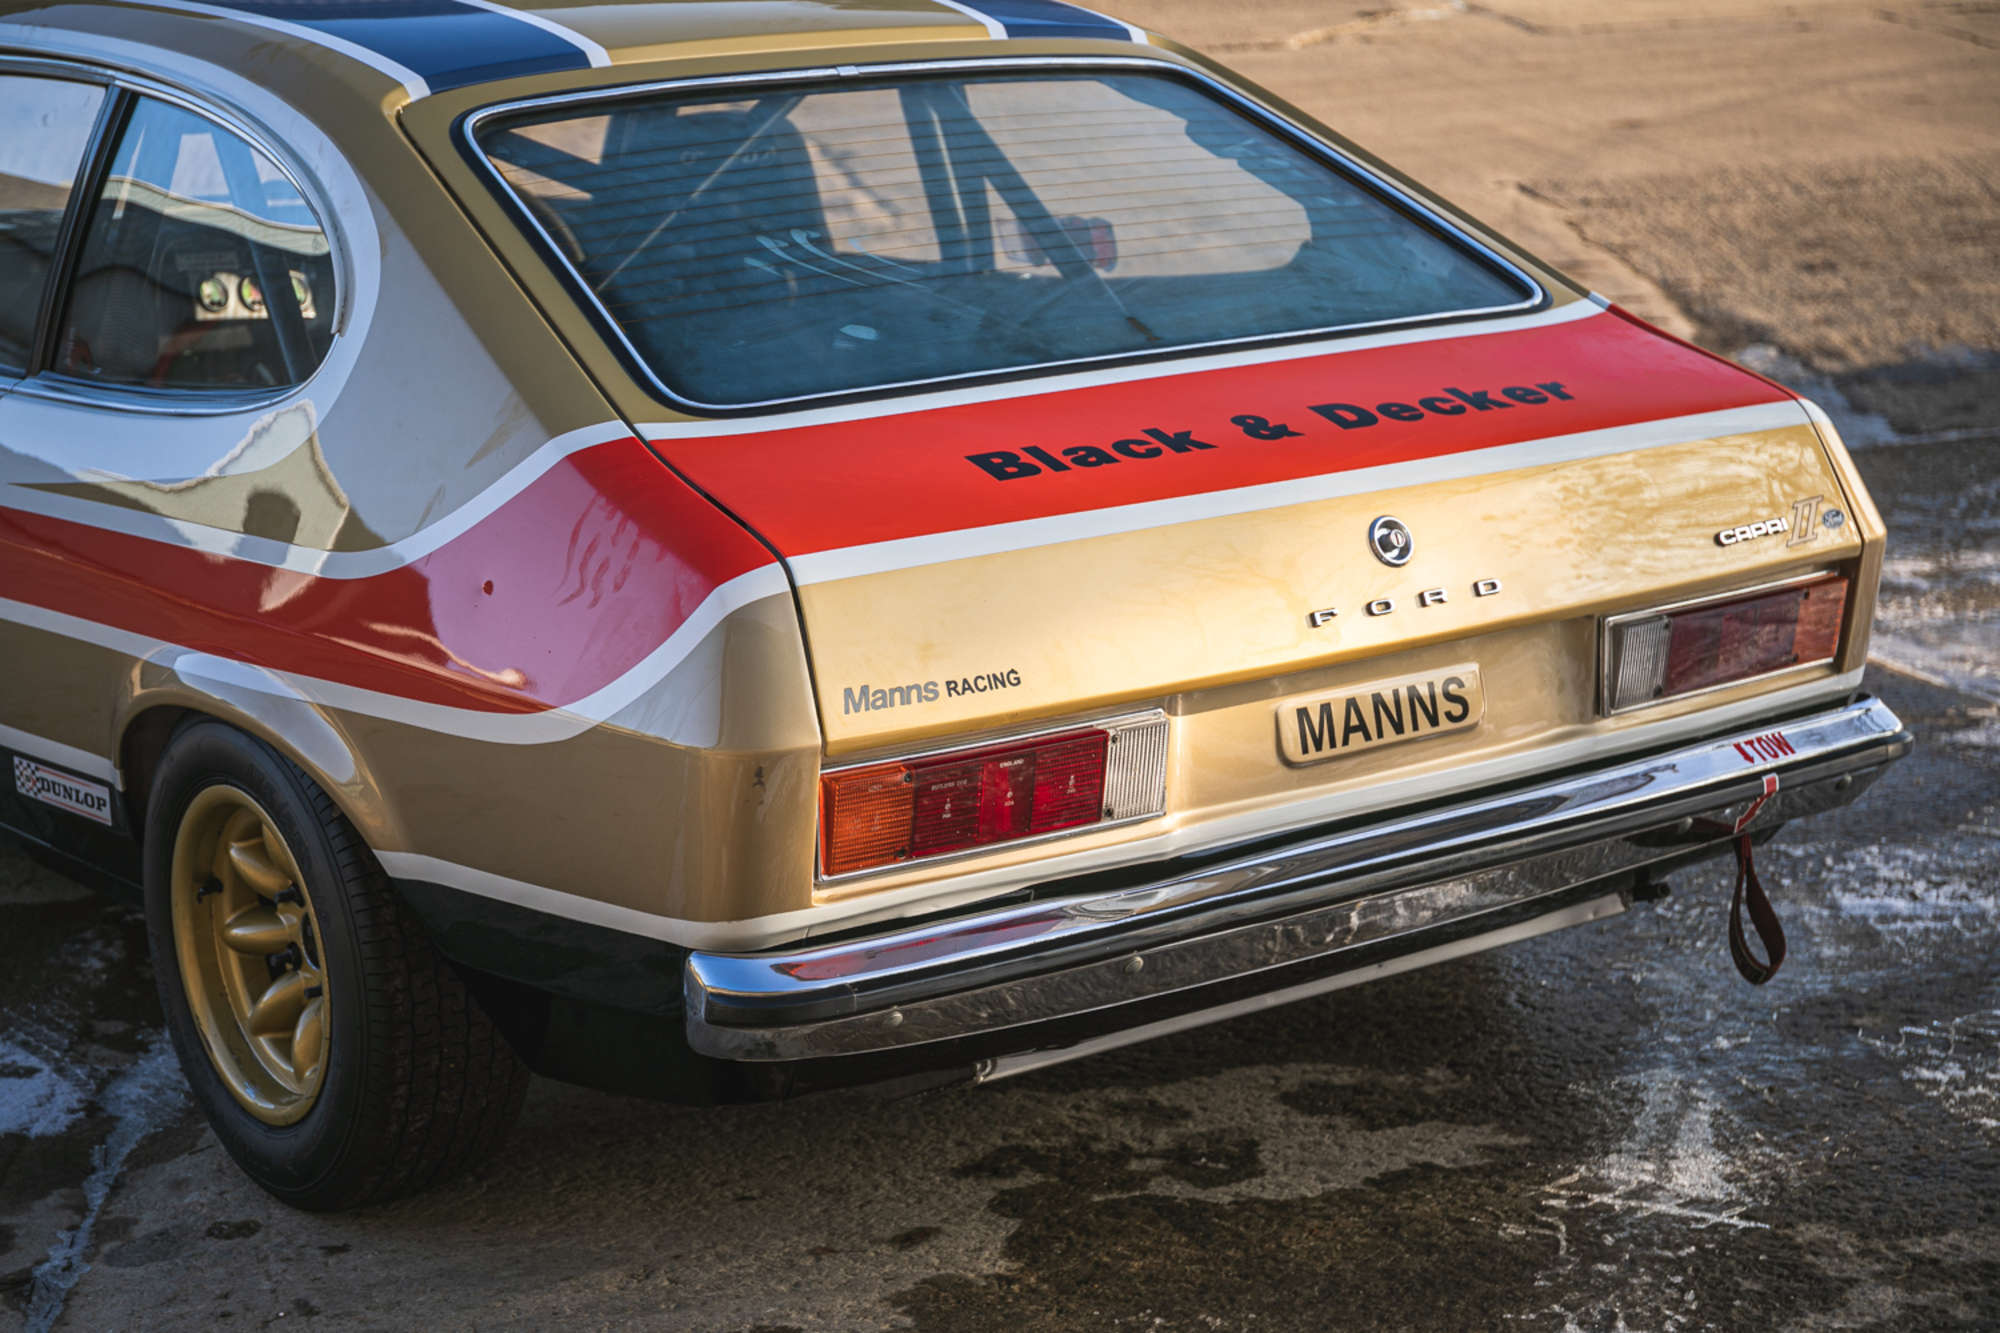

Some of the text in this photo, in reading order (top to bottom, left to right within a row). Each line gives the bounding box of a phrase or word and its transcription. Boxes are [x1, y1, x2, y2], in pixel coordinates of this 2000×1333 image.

[965, 381, 1575, 481] Black & Decker
[1713, 517, 1789, 547] CAPRI
[1308, 577, 1501, 628] FORD
[843, 669, 1022, 715] Manns RACING
[1296, 676, 1470, 756] MANNS
[1744, 731, 1796, 762] TOW
[40, 778, 107, 812] DUNLOP
